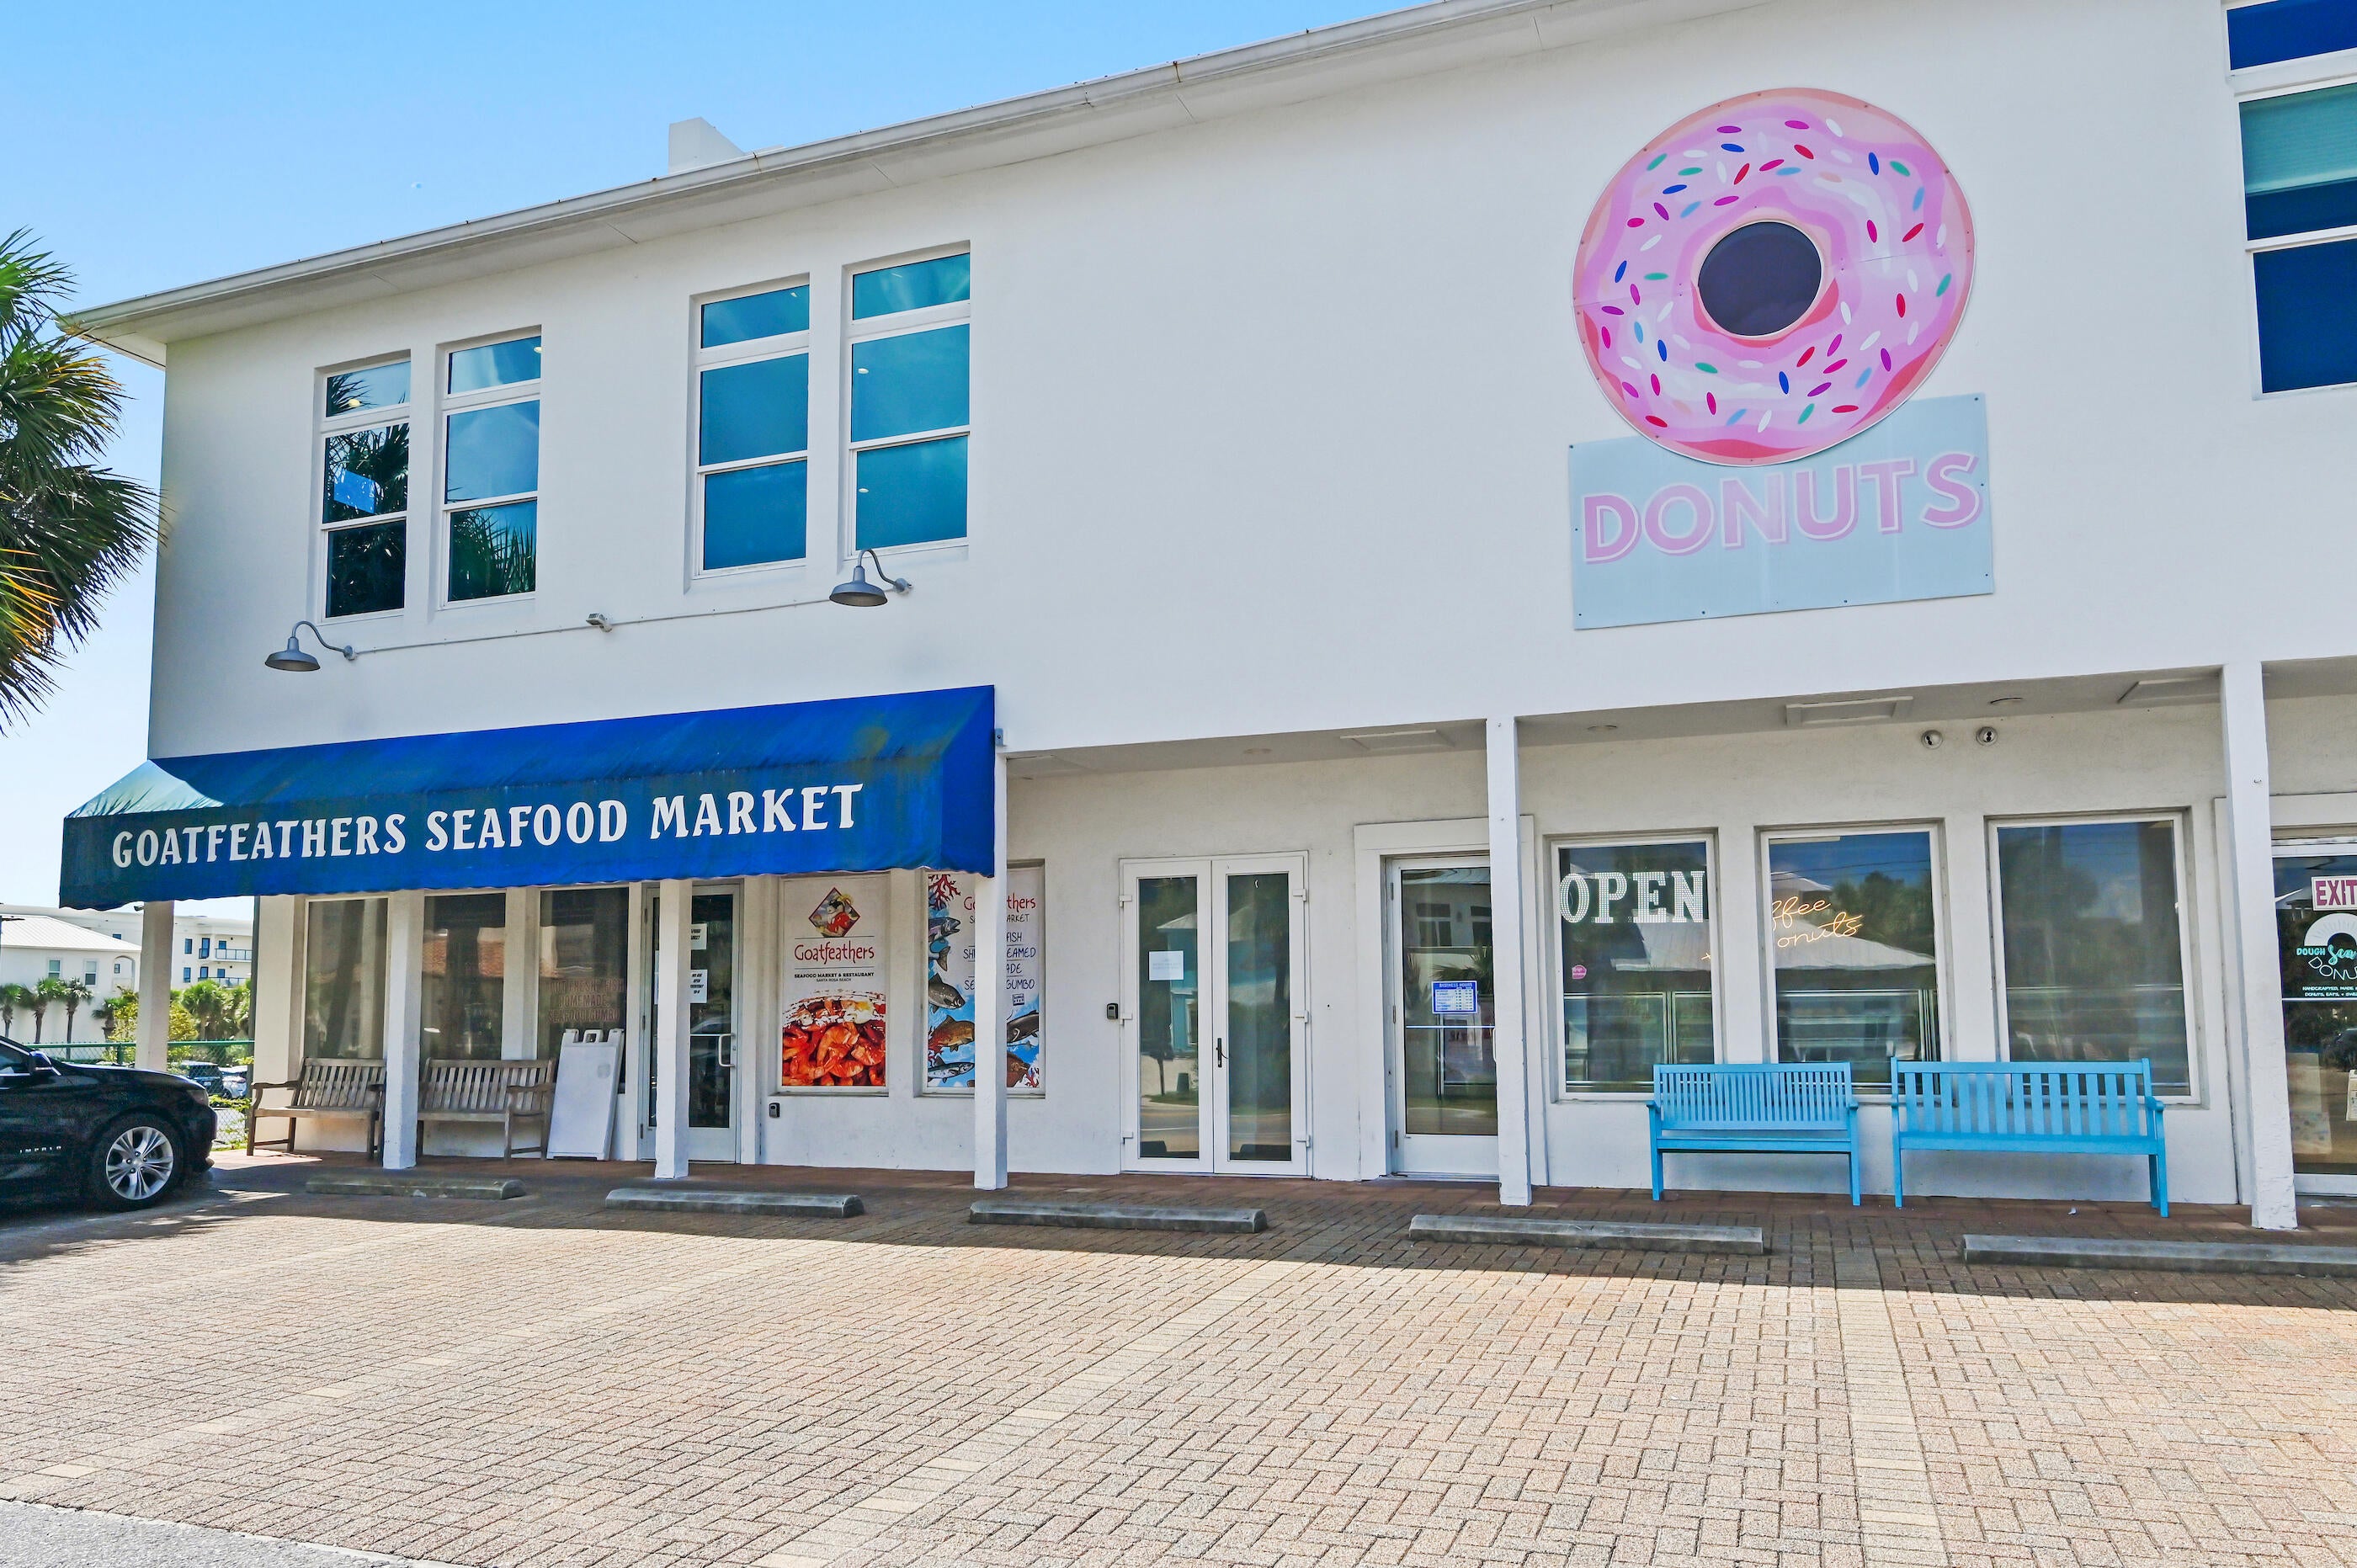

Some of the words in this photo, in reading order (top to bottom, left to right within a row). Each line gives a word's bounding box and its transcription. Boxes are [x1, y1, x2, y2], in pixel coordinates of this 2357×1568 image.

[1583, 452, 1984, 566] DONUTS
[113, 813, 407, 869] GOATFEATHERS
[425, 800, 628, 852] SEAFOOD
[650, 783, 864, 840] MARKET
[1560, 870, 1705, 923] OPEN
[2315, 880, 2357, 906] EXIT
[1006, 913, 1030, 923] ARKET
[1777, 912, 1863, 948] onuts
[794, 939, 875, 965] Goatfeathers
[1006, 948, 1036, 959] EAMED
[2296, 947, 2326, 956] DOUGH
